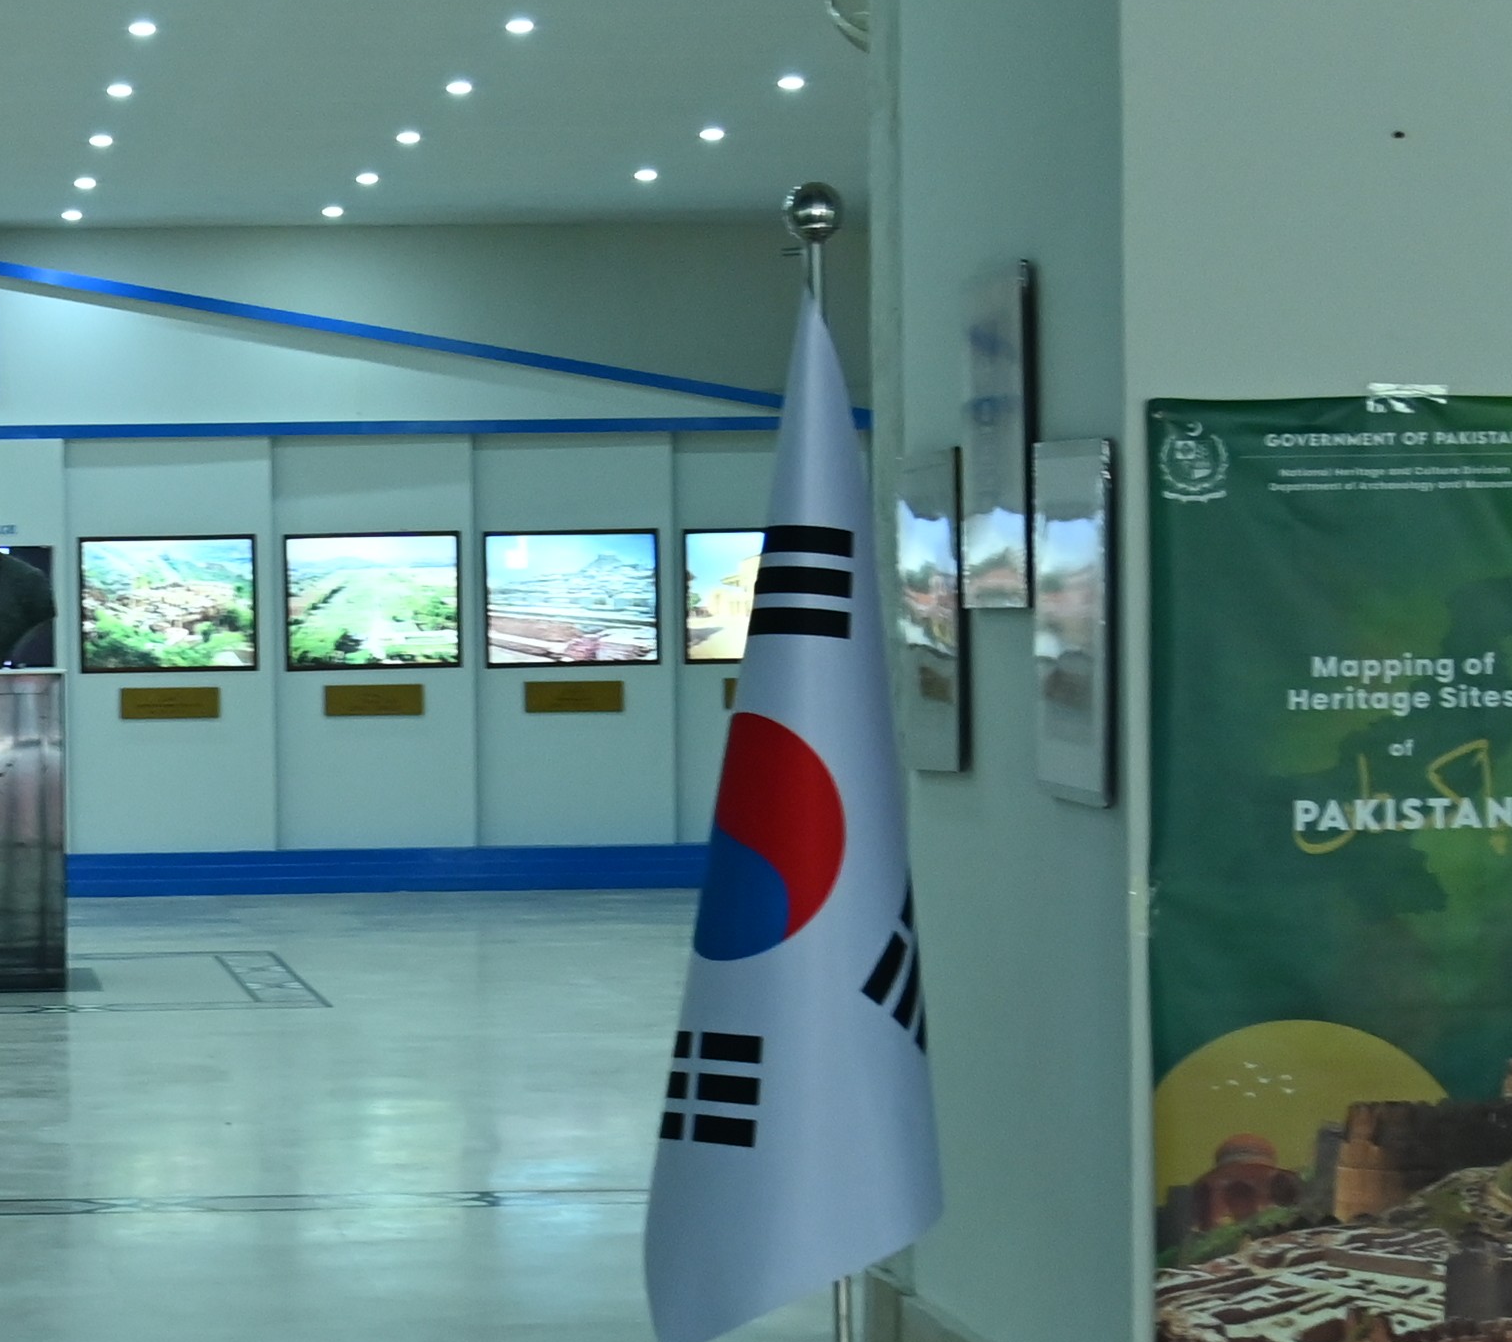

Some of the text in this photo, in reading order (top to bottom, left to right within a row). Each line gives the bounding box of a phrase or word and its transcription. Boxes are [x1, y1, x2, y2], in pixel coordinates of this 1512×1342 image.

[1264, 433, 1396, 447] GOVERNMENT
[1401, 432, 1429, 445] OF
[1311, 652, 1496, 684] Mapping of
[1287, 687, 1431, 714] Heritage
[1389, 739, 1414, 757] of
